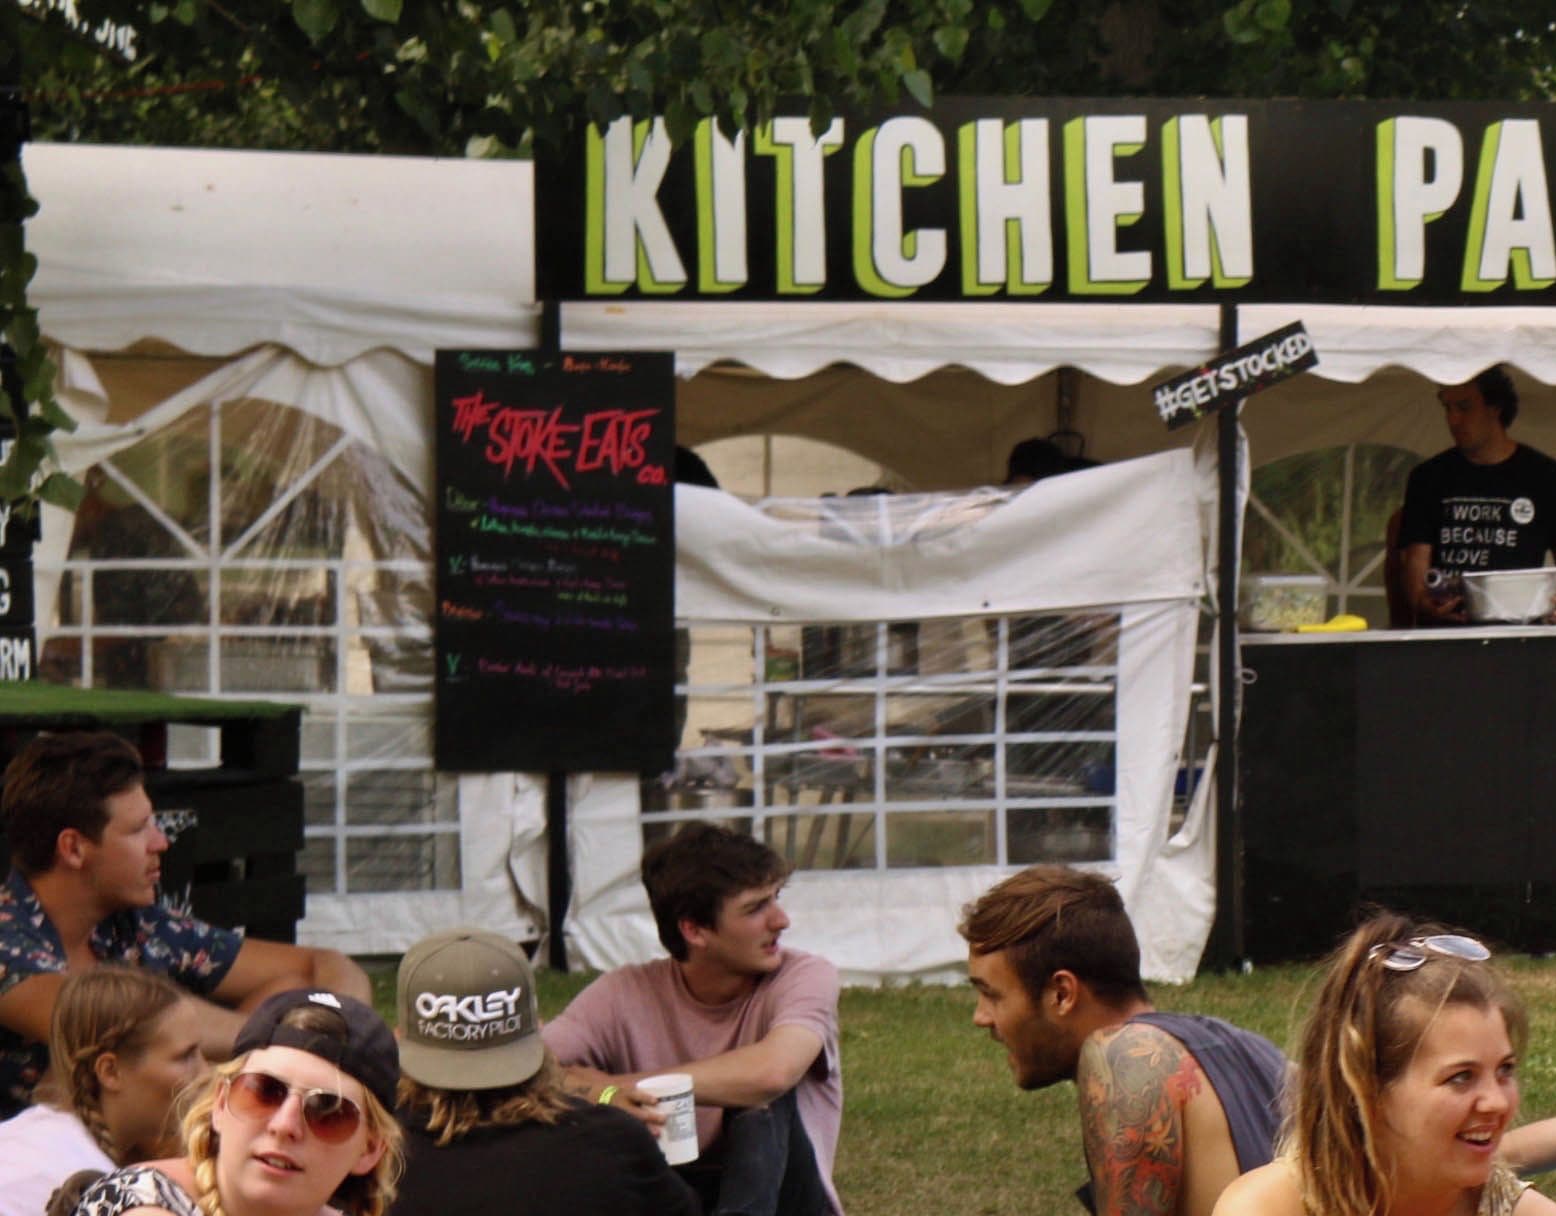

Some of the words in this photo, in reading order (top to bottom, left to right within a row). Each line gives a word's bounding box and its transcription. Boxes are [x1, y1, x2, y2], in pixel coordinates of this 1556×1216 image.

[585, 114, 1254, 297] KITCHEN
[453, 388, 500, 444] THE
[485, 404, 581, 490] STOKE
[575, 408, 662, 476] EATS
[1453, 504, 1503, 522] WORK
[1440, 526, 1518, 548] BECAUSE
[1446, 548, 1491, 567] LOVE
[415, 986, 521, 1024] OAKLEY
[417, 1018, 490, 1042] FACTORY
[489, 1015, 521, 1037] PILOT
